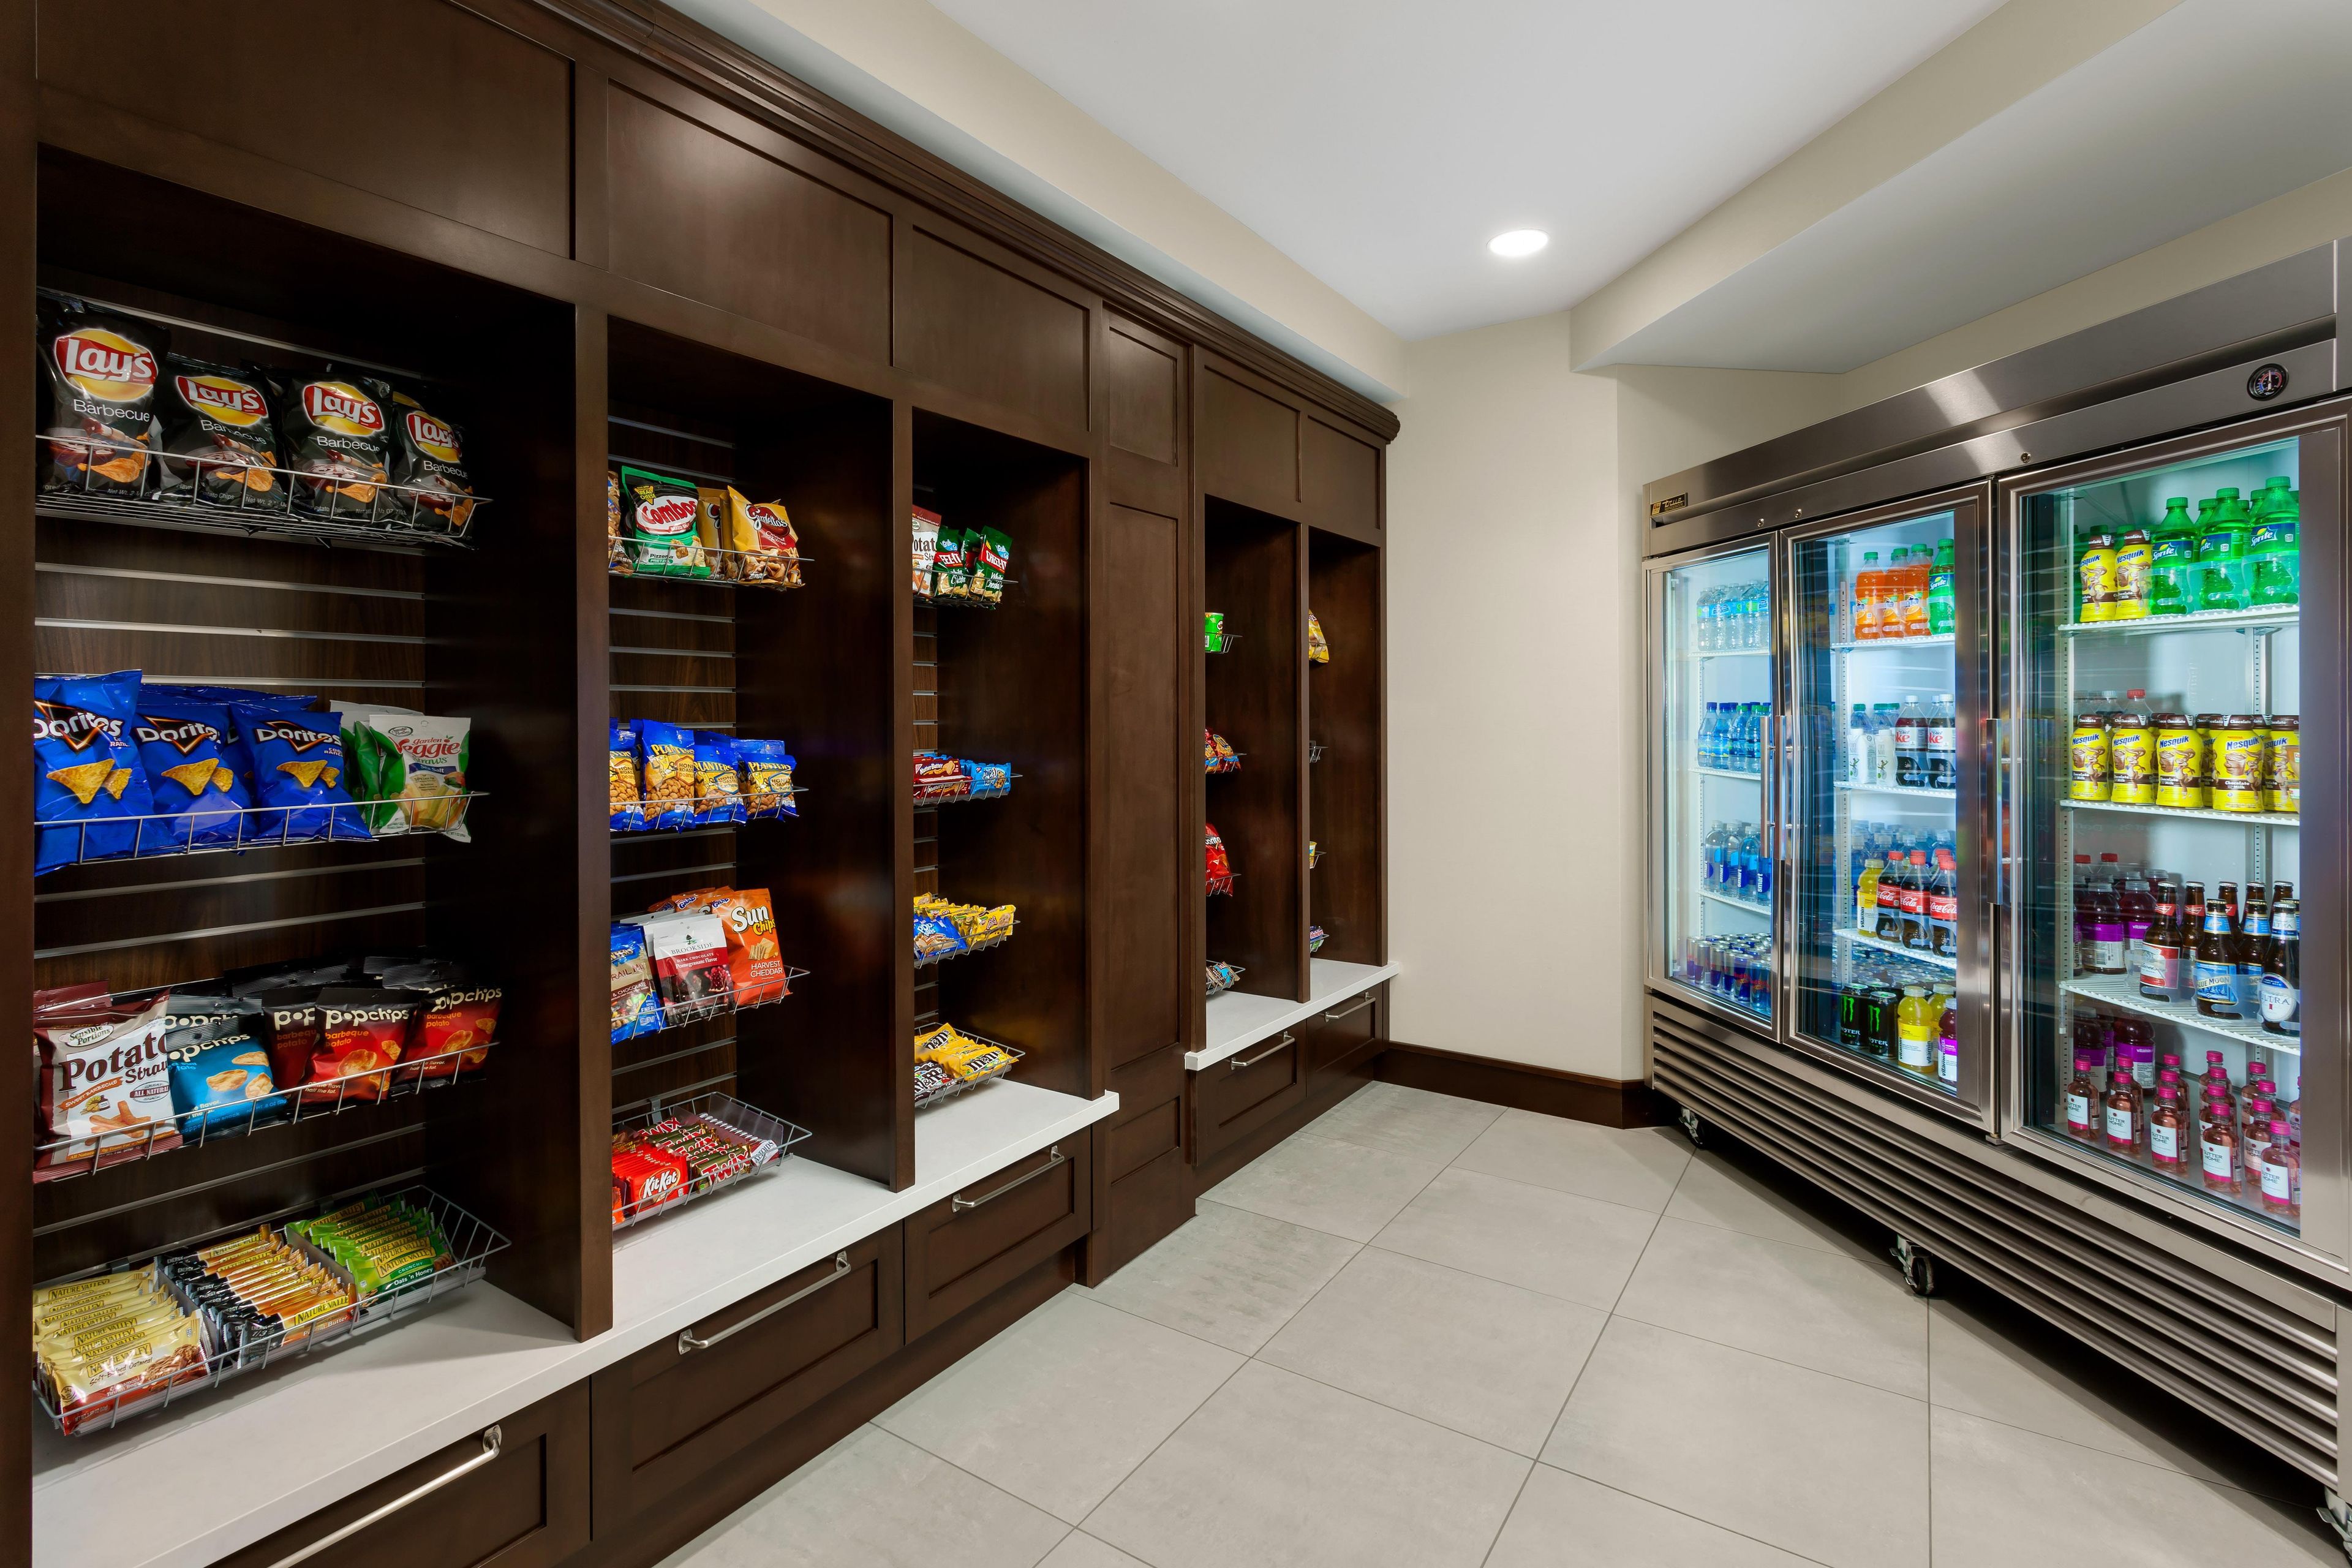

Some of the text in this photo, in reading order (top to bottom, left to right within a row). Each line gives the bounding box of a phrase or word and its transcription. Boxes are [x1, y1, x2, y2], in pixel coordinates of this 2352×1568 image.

[66, 339, 153, 382] Lay's
[187, 380, 262, 412] Lay's
[74, 399, 151, 423] Barbecue
[313, 386, 377, 424] Lay's
[416, 415, 459, 448] Lay's
[1662, 497, 1683, 508] true
[642, 499, 696, 526] Combos
[745, 503, 789, 531] Gardetto's
[2250, 530, 2275, 547] Sprite
[986, 549, 1008, 570] CHEEZ-IT
[2152, 546, 2175, 561] Sprite
[1929, 579, 1947, 590] Sprite
[256, 728, 342, 746] Doritos
[2072, 733, 2100, 745] Nesquik
[2113, 734, 2141, 747] Nesquik
[2159, 735, 2190, 749] Nesquik
[2226, 737, 2260, 751] Nesquik
[388, 736, 462, 759] Veggie
[748, 761, 791, 772] PLANTERS
[731, 905, 769, 933] Sun
[753, 919, 776, 936] Chips
[671, 941, 714, 955] BROOKSIDE
[676, 959, 705, 970] Pomegranate
[750, 967, 783, 978] CHEDDAR
[751, 960, 781, 970] HARVEST
[611, 968, 631, 981] RAIL
[2208, 976, 2230, 985] MOON
[617, 981, 647, 995] CHOCOLATE
[325, 1007, 409, 1030] popchips
[426, 1019, 450, 1028] potato
[69, 1025, 104, 1042] Sensible
[77, 1028, 111, 1046] Portions
[325, 1029, 369, 1040] barbeque
[168, 1033, 251, 1063] opchips
[277, 1039, 307, 1049] potato
[325, 1037, 352, 1048] potato
[65, 1079, 118, 1107] SWEET BARBECUE
[221, 1112, 241, 1121] snack
[2108, 1115, 2125, 1124] SUTTER
[313, 1202, 364, 1227] NATURE VALLEY
[376, 1237, 429, 1265] NATURE VALLEY
[380, 1248, 434, 1275] NATURE VALLEY
[398, 1261, 423, 1274] CRUNCHY
[394, 1276, 408, 1286] Oats
[415, 1267, 434, 1278] Honey
[50, 1283, 79, 1300] NATURE
[78, 1279, 109, 1291] VALLEY
[197, 1283, 215, 1292] ENERGY
[43, 1307, 74, 1324] NATURE
[74, 1301, 103, 1314] VALLEY
[298, 1303, 328, 1323] NATURE
[328, 1315, 349, 1327] Butter
[77, 1318, 136, 1344] NATURE VALLEY
[129, 1358, 153, 1370] Oatmeal
